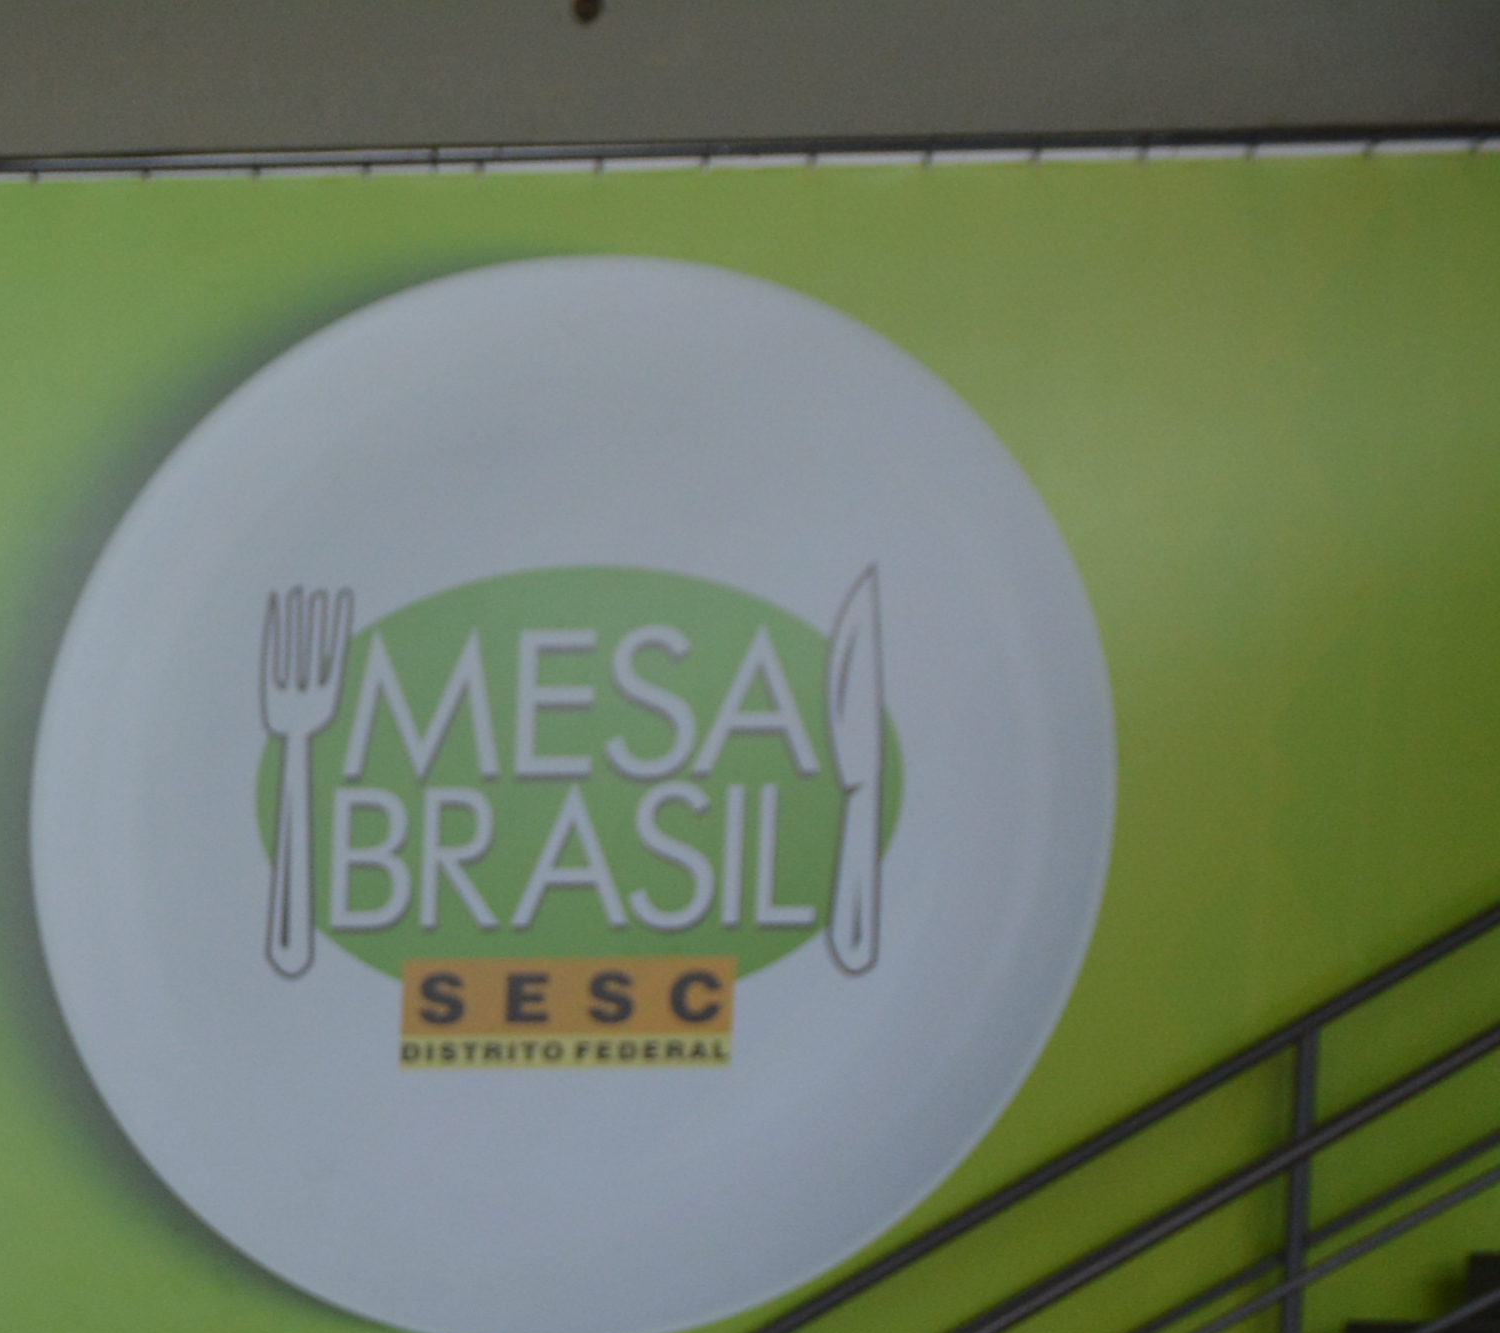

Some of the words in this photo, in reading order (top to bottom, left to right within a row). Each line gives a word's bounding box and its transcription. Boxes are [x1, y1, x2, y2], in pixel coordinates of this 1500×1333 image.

[342, 624, 820, 781] MESA
[328, 783, 816, 931] BRASIL
[419, 970, 722, 1024] SESC
[401, 1040, 564, 1062] DISTRITO
[575, 1038, 729, 1061] FEDERAL
